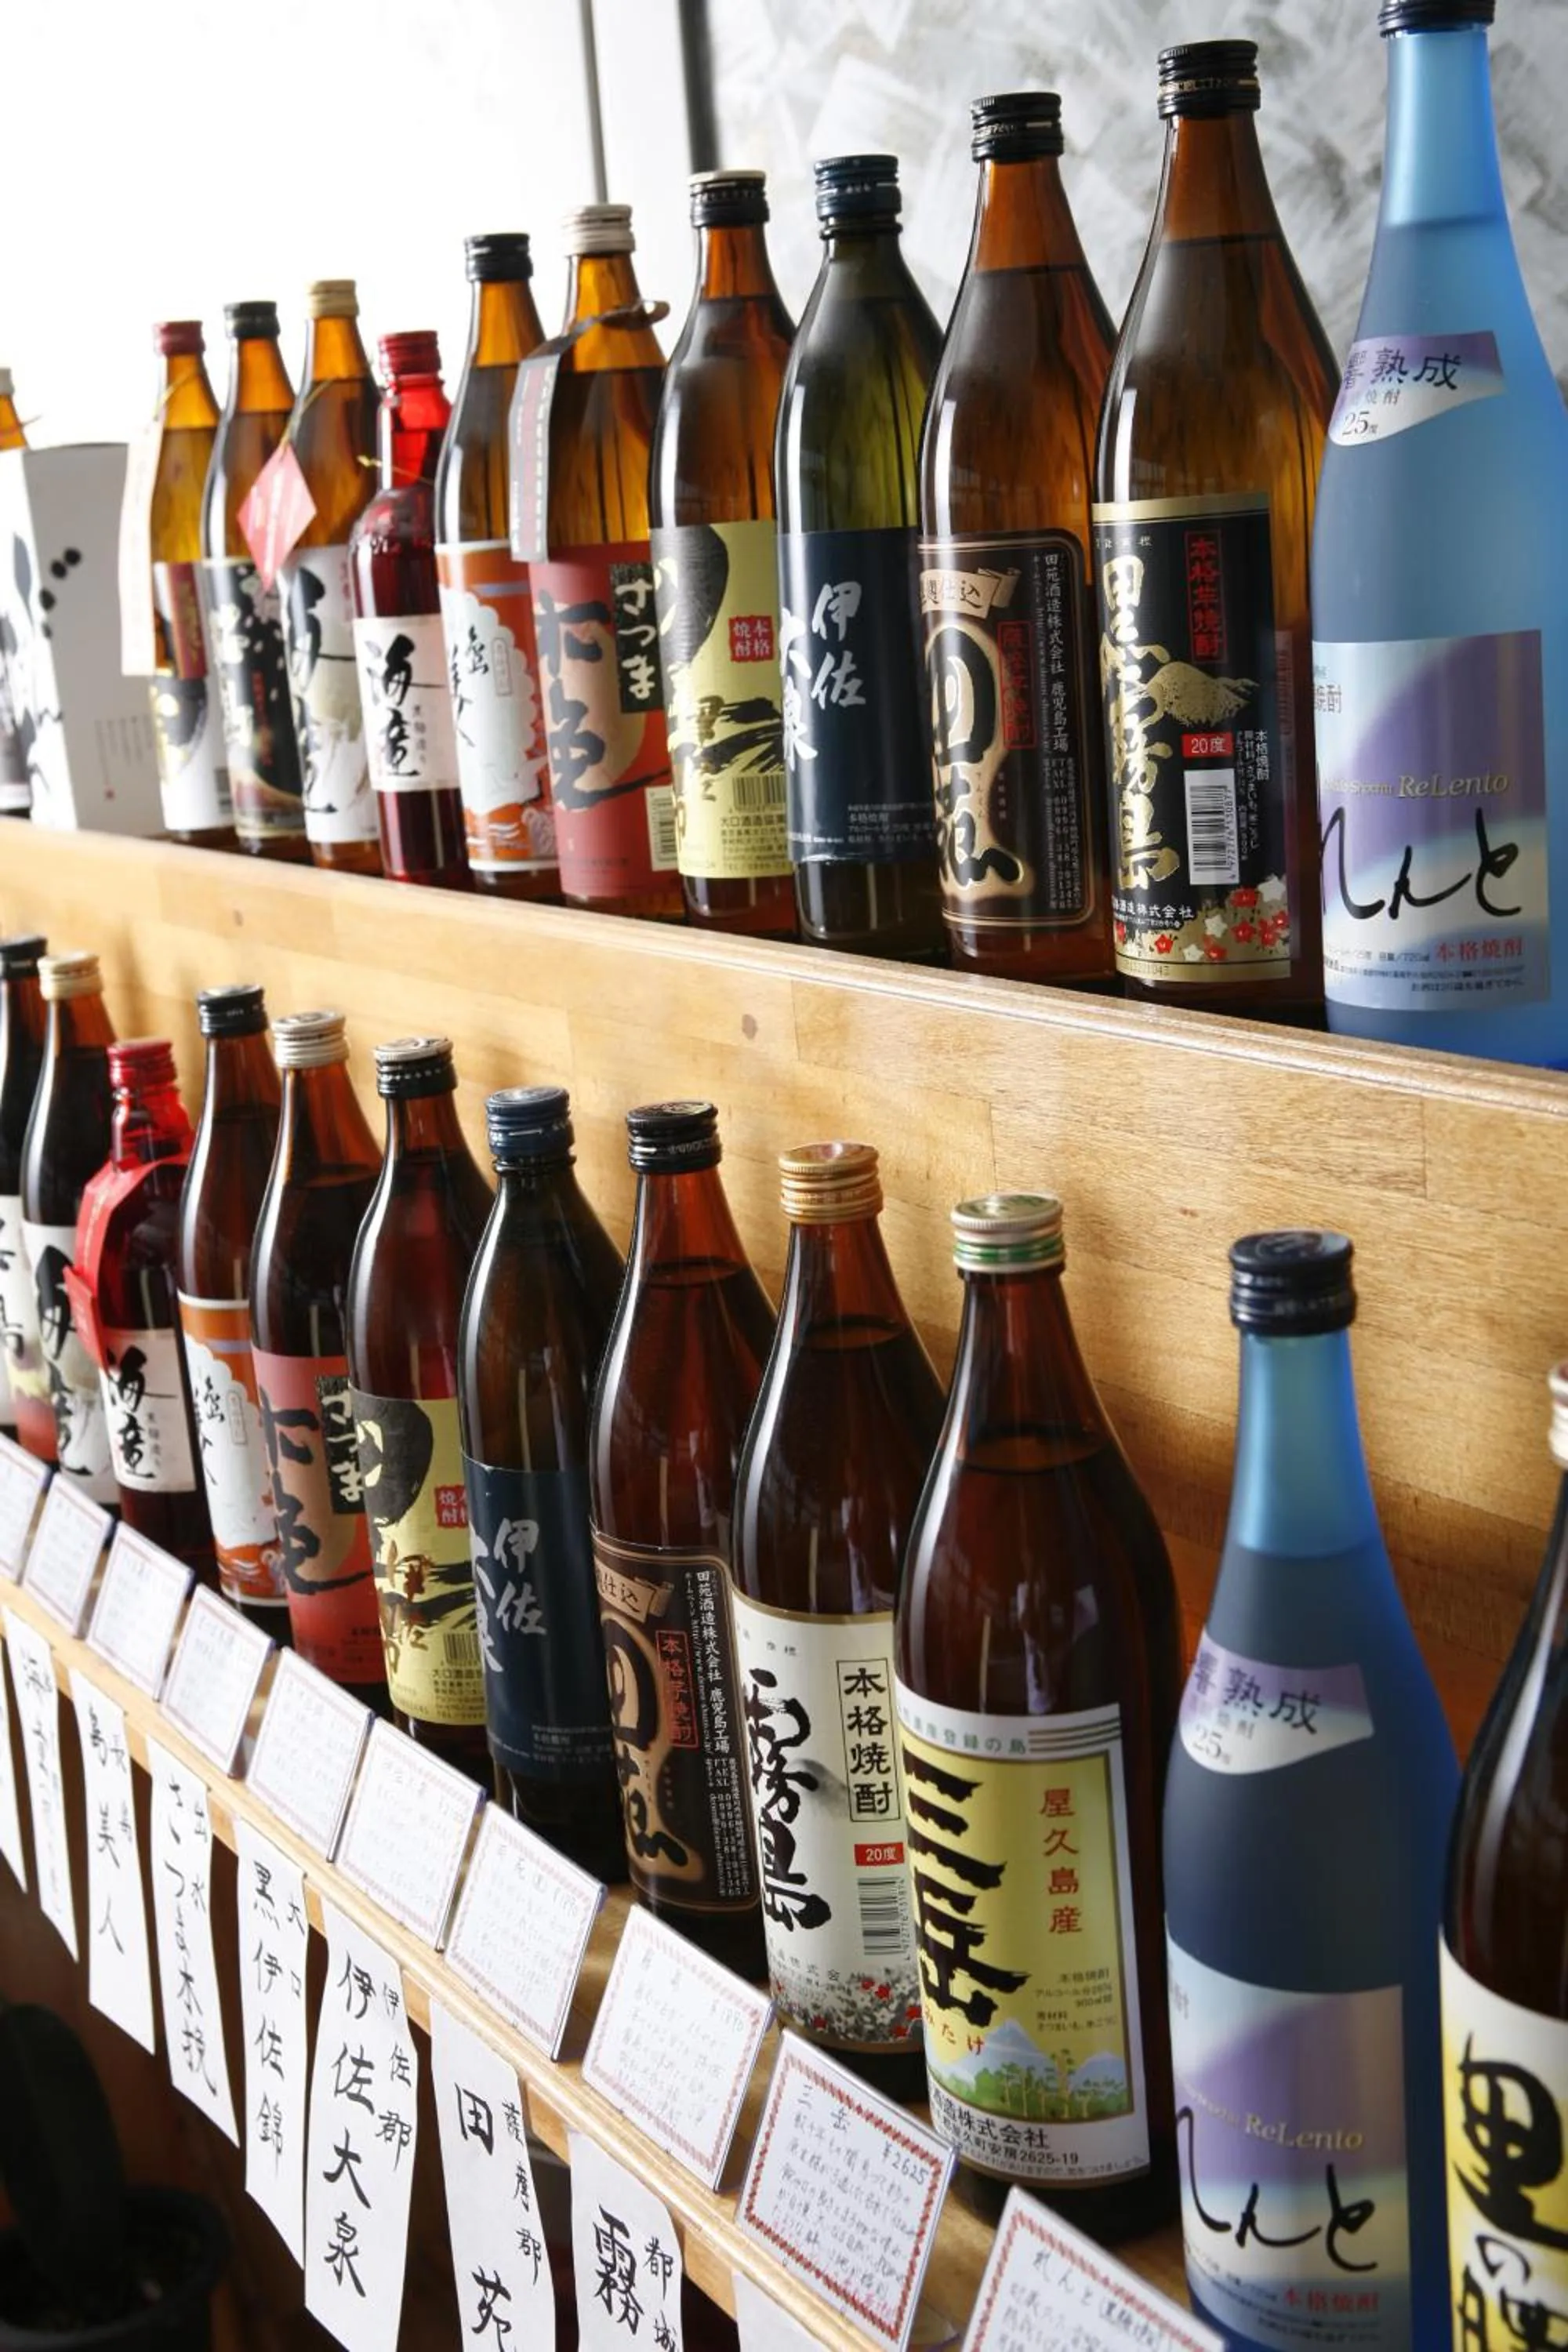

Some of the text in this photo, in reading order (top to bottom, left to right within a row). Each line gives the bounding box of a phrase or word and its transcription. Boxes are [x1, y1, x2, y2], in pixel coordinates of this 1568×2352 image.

[617, 578, 656, 699] さつま
[811, 581, 866, 710] 伊佐
[1101, 556, 1180, 890] 黒霧島
[1189, 737, 1228, 755] 20度
[1317, 808, 1523, 920] れんと
[1436, 938, 1523, 964] 本格焼酎
[492, 1517, 547, 1635] 伊佐
[696, 1570, 722, 1682] 田苑酒造株式会社
[709, 1687, 731, 1754] 鹿児島工場
[843, 1666, 892, 1815] 本格焼酎
[865, 1847, 898, 1864] 20度
[903, 1742, 1032, 2030] 三岳
[1039, 1788, 1083, 1935] 屋久島産
[252, 1860, 284, 2176] 黒伊佐錦
[375, 1982, 413, 2172] 伊佐郡
[323, 1955, 376, 2299] 伊佐大泉
[881, 2141, 930, 2187] ¥2625
[1283, 2286, 1381, 2314] 本格焼酎
